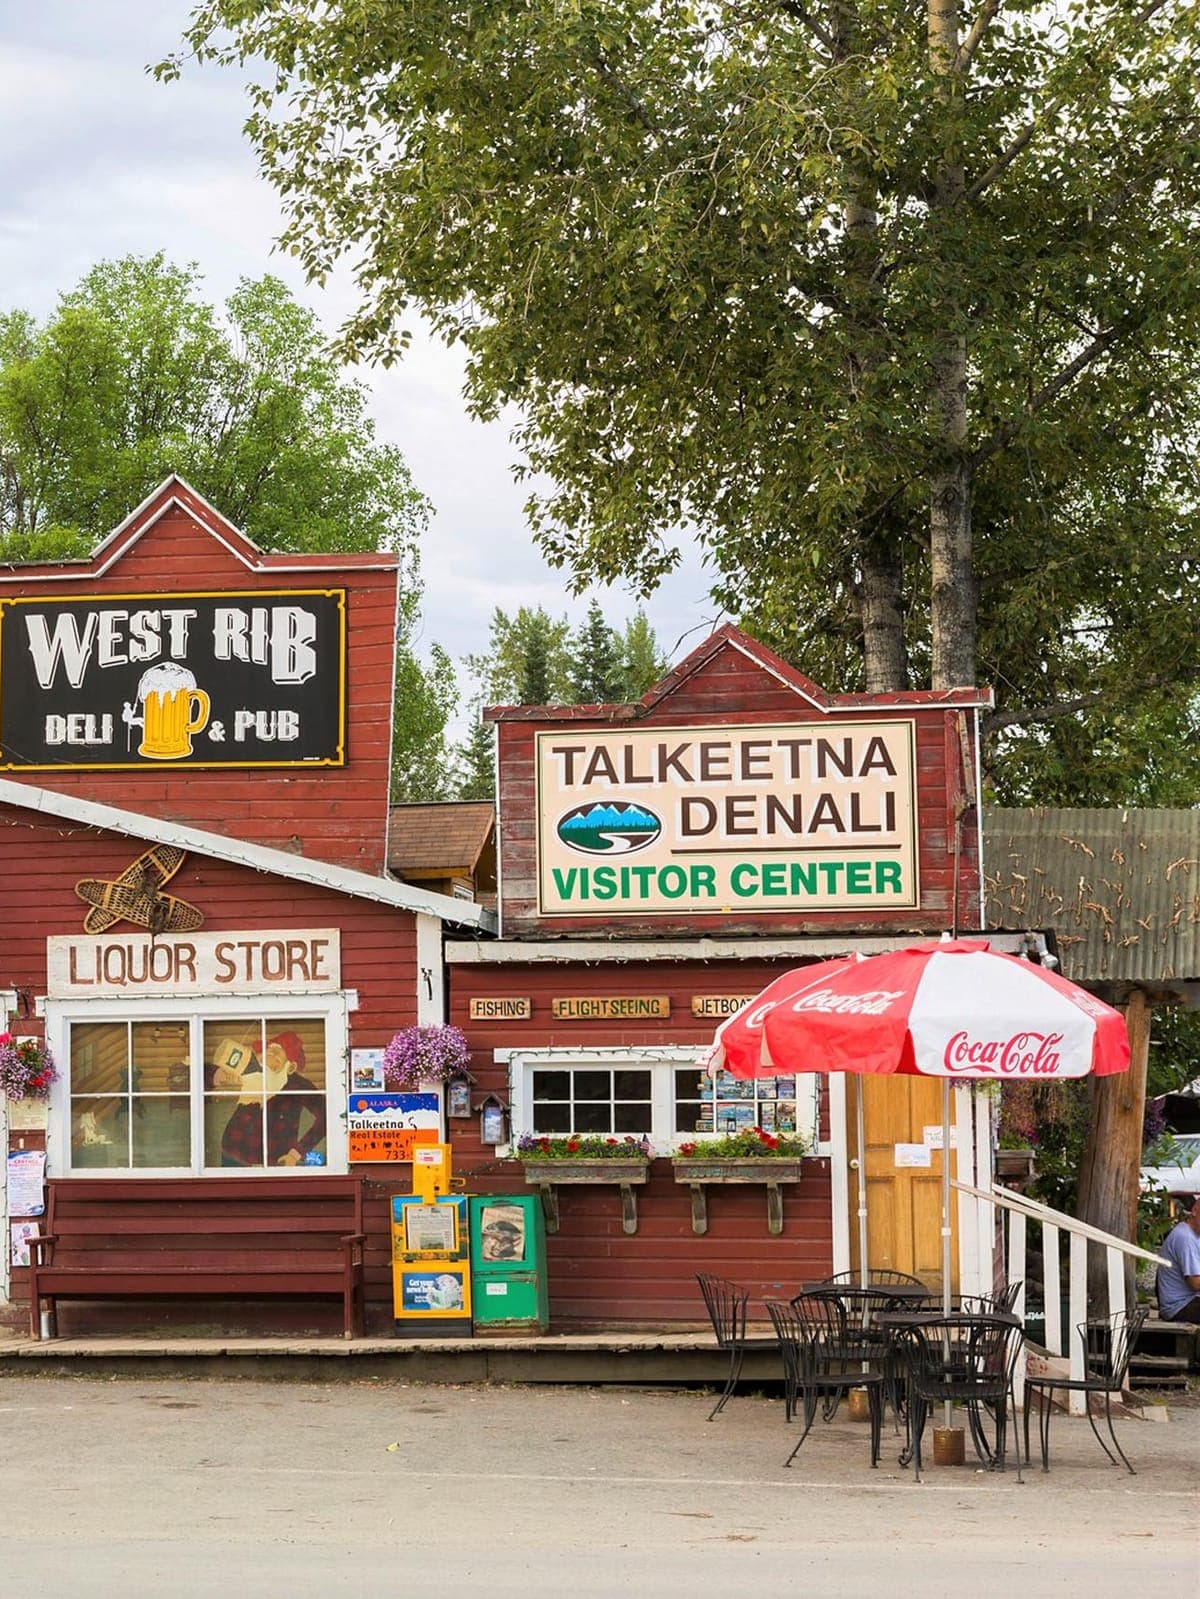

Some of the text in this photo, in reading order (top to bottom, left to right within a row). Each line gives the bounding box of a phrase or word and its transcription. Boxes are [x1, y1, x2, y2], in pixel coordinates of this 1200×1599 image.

[24, 606, 318, 691] WEST RIB
[45, 710, 300, 746] DELI & PUB
[551, 736, 898, 786] TALKEETNA
[681, 791, 897, 837] DENALI
[552, 860, 903, 901] VISITOR CENTER
[69, 939, 330, 986] LIQUOR STORE
[475, 1000, 526, 1016] FISHING
[697, 998, 752, 1014] JETBOA
[942, 1031, 1066, 1074] Coca-Cola
[369, 1099, 399, 1107] ALASKA
[350, 1119, 405, 1130] Talkeetna
[350, 1130, 401, 1139] Real Estate
